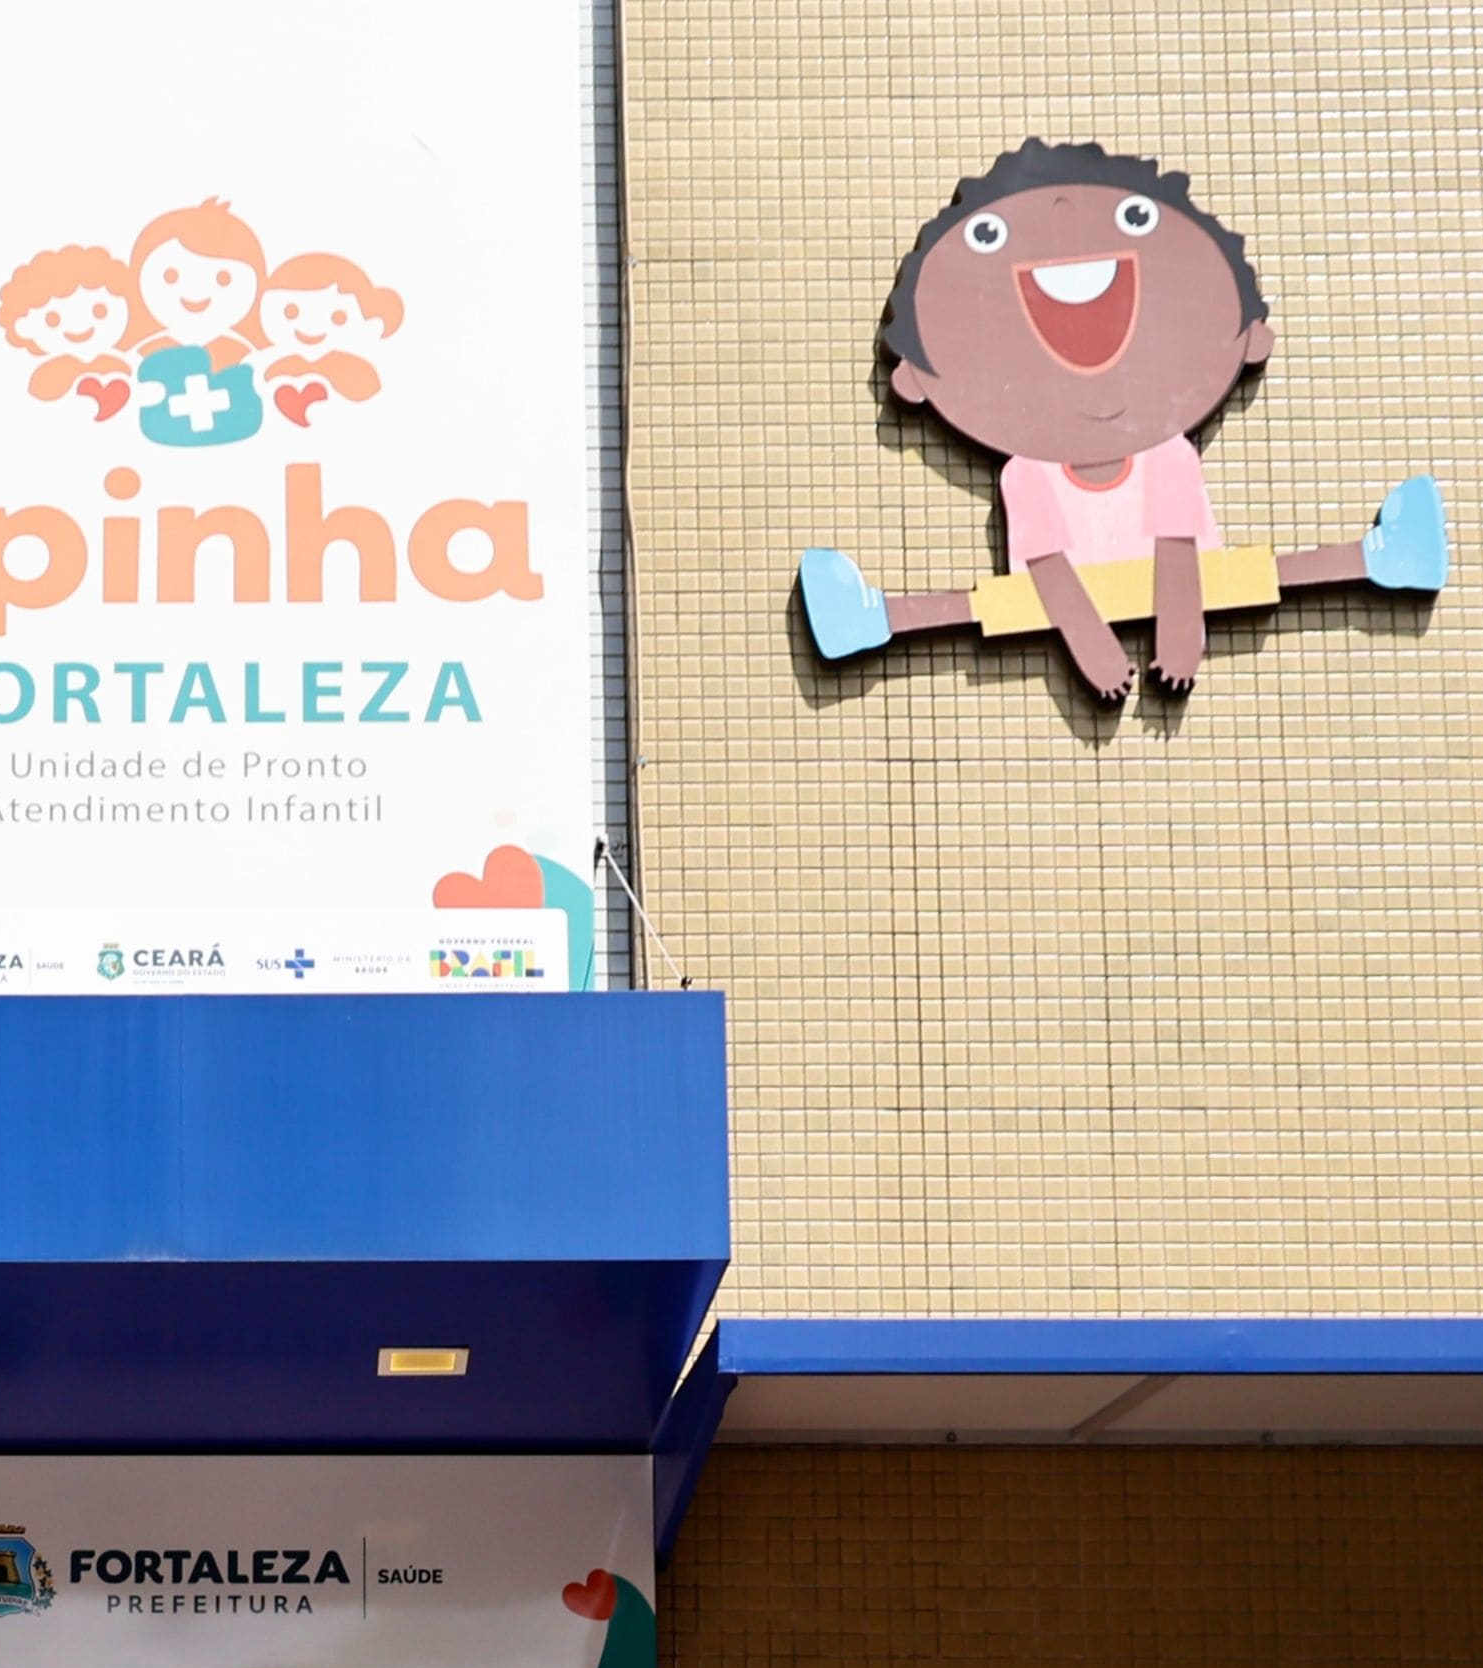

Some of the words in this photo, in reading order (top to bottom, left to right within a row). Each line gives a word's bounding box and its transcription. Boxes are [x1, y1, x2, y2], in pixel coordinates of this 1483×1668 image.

[10, 750, 167, 779] Unidade
[182, 750, 226, 779] de
[242, 750, 368, 779] Pronto
[246, 794, 383, 823] Infantil
[132, 942, 226, 967] CEARÁ
[256, 957, 282, 970] SUS
[429, 949, 545, 977] BRASIL
[69, 1549, 350, 1585] FORTALEZA
[377, 1564, 444, 1585] SAÚDE
[107, 1594, 313, 1614] PREFEITURA
